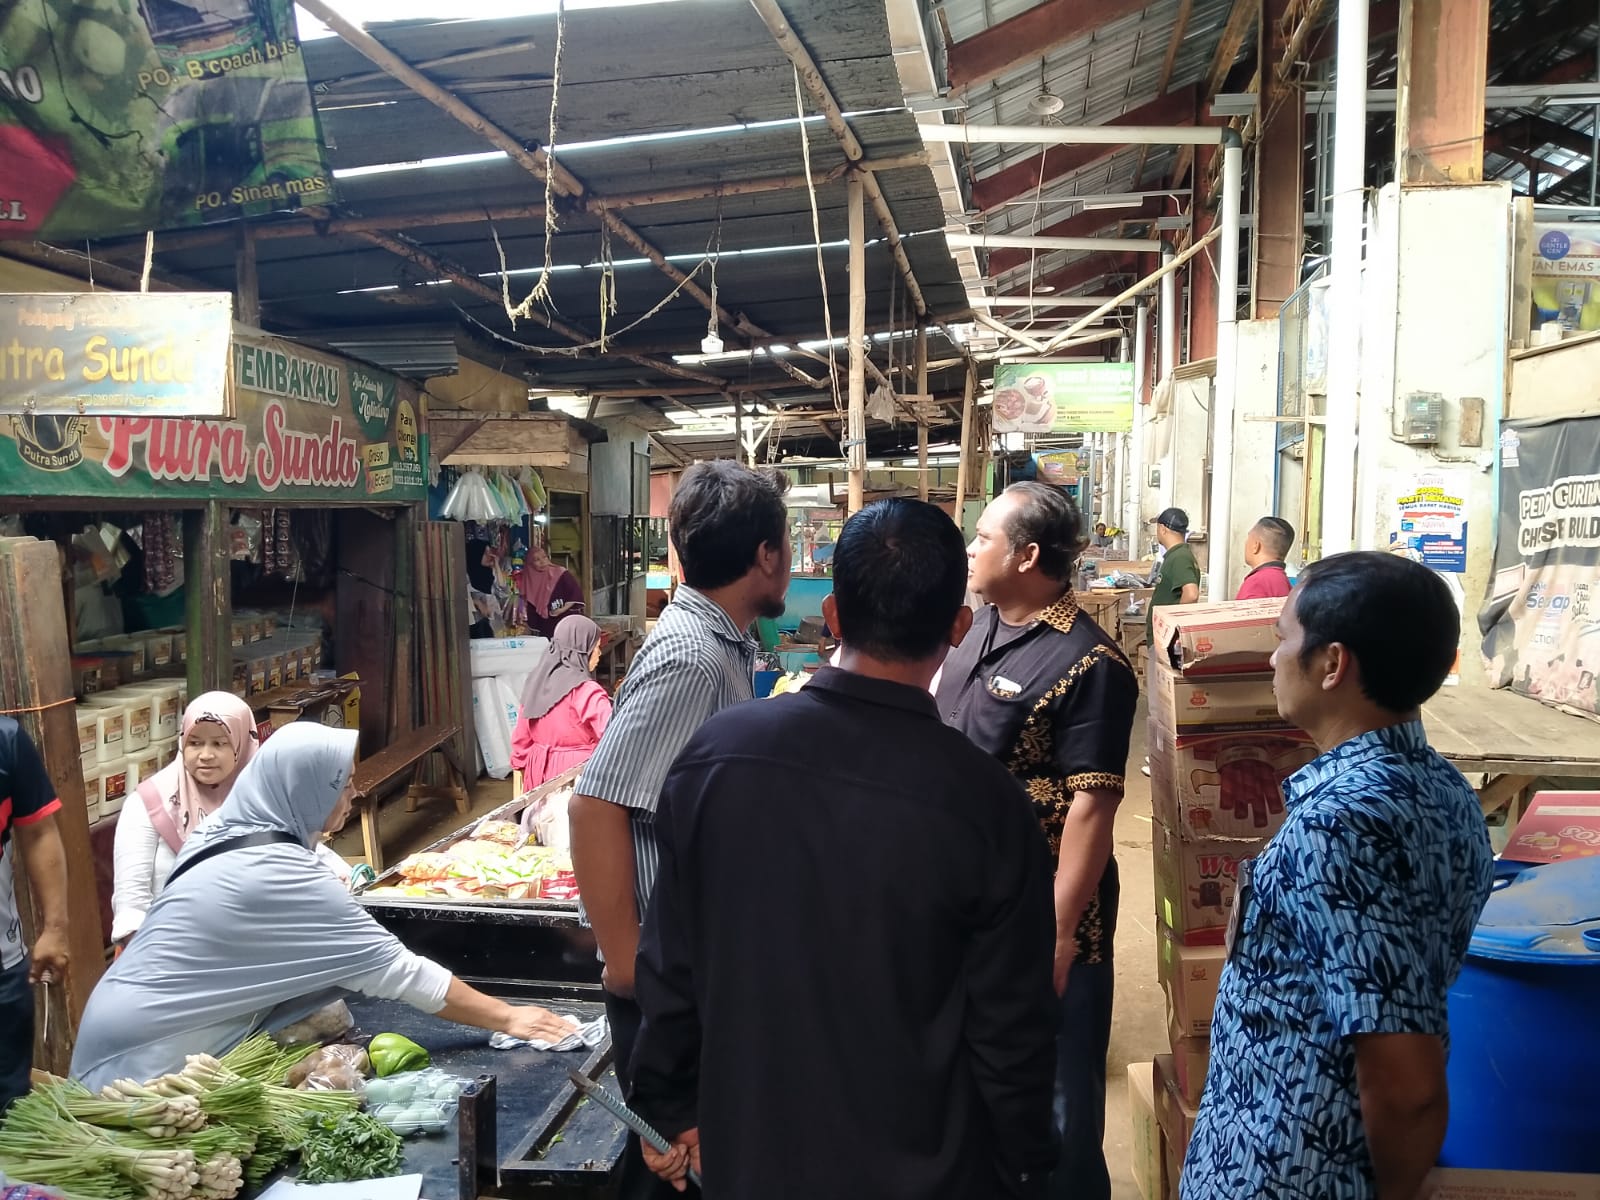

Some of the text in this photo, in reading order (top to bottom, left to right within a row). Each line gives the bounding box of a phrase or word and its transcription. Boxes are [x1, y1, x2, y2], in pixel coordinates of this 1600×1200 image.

[138, 68, 178, 90] PO.
[208, 47, 263, 75] coach
[264, 38, 298, 64] bus
[194, 175, 327, 211] PO. Sinar mas
[1558, 261, 1595, 273] EMAS
[234, 345, 341, 408] EMBAKAU
[24, 445, 80, 466] Putra Sunda
[256, 399, 360, 493] Sunda
